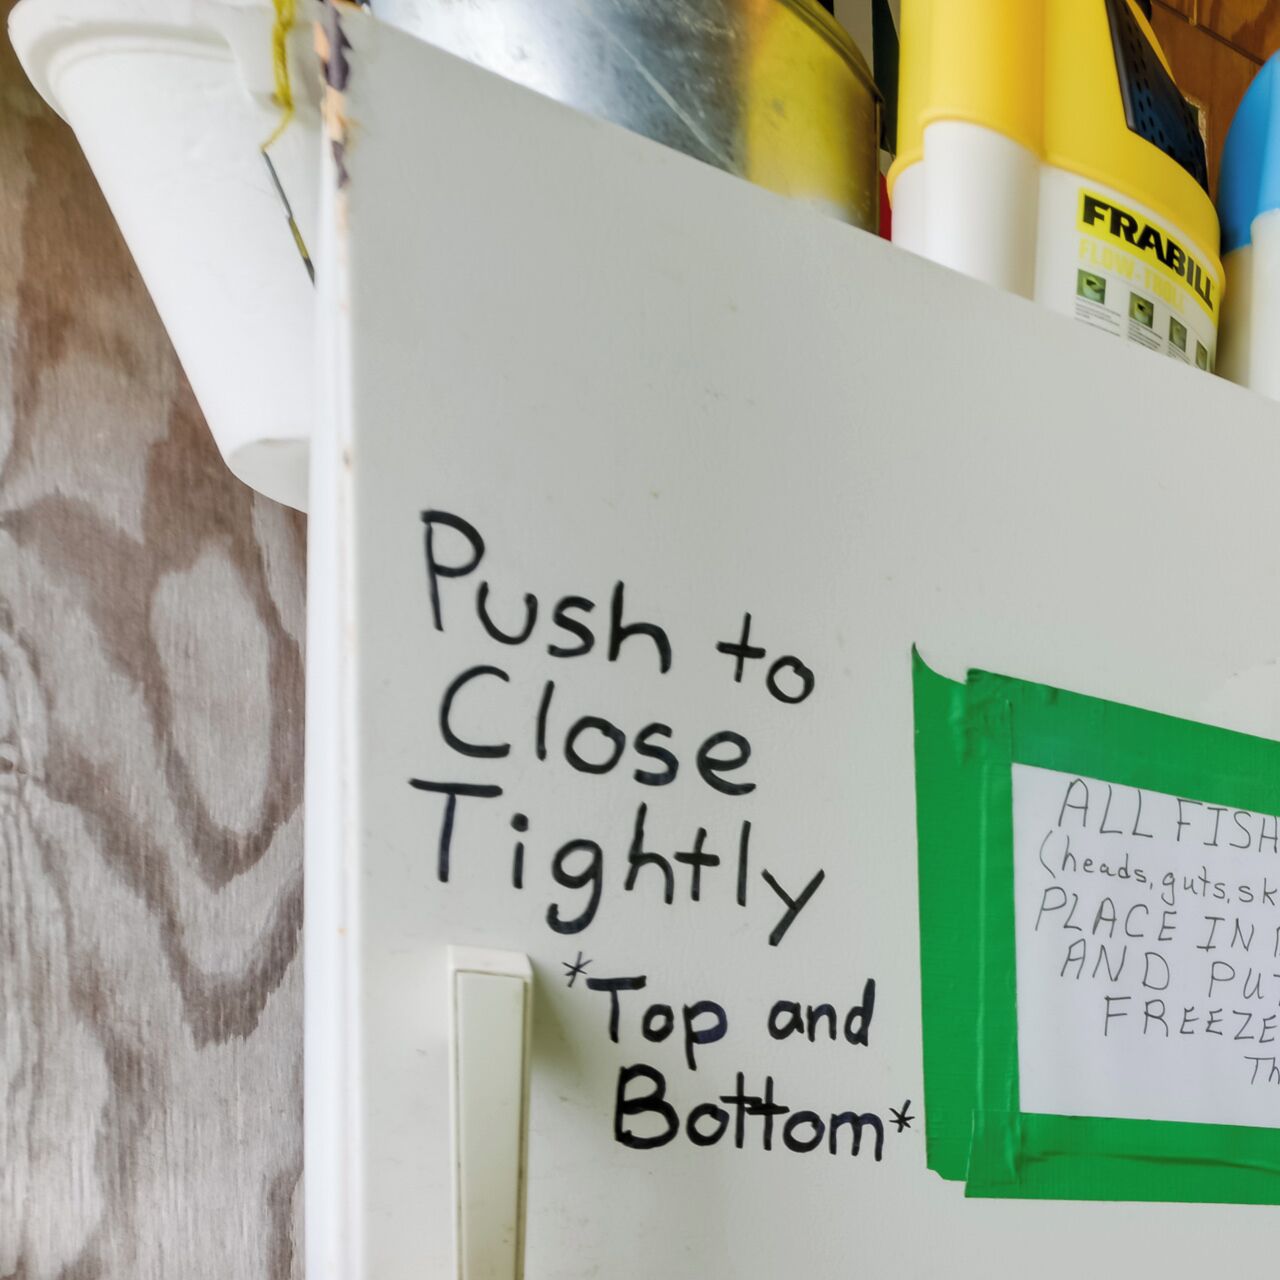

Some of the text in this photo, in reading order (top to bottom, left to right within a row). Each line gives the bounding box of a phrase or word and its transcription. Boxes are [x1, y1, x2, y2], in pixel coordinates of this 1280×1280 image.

[1082, 193, 1214, 312] FRABILL
[420, 509, 815, 704] Push to
[439, 664, 757, 796] Close
[408, 778, 826, 947] Tightly
[1058, 777, 1154, 838] ALL
[1176, 797, 1279, 854] FISH
[1035, 885, 1178, 943] PLACE
[1196, 915, 1256, 952] IN
[1060, 938, 1171, 991] AND
[768, 977, 877, 1047] and
